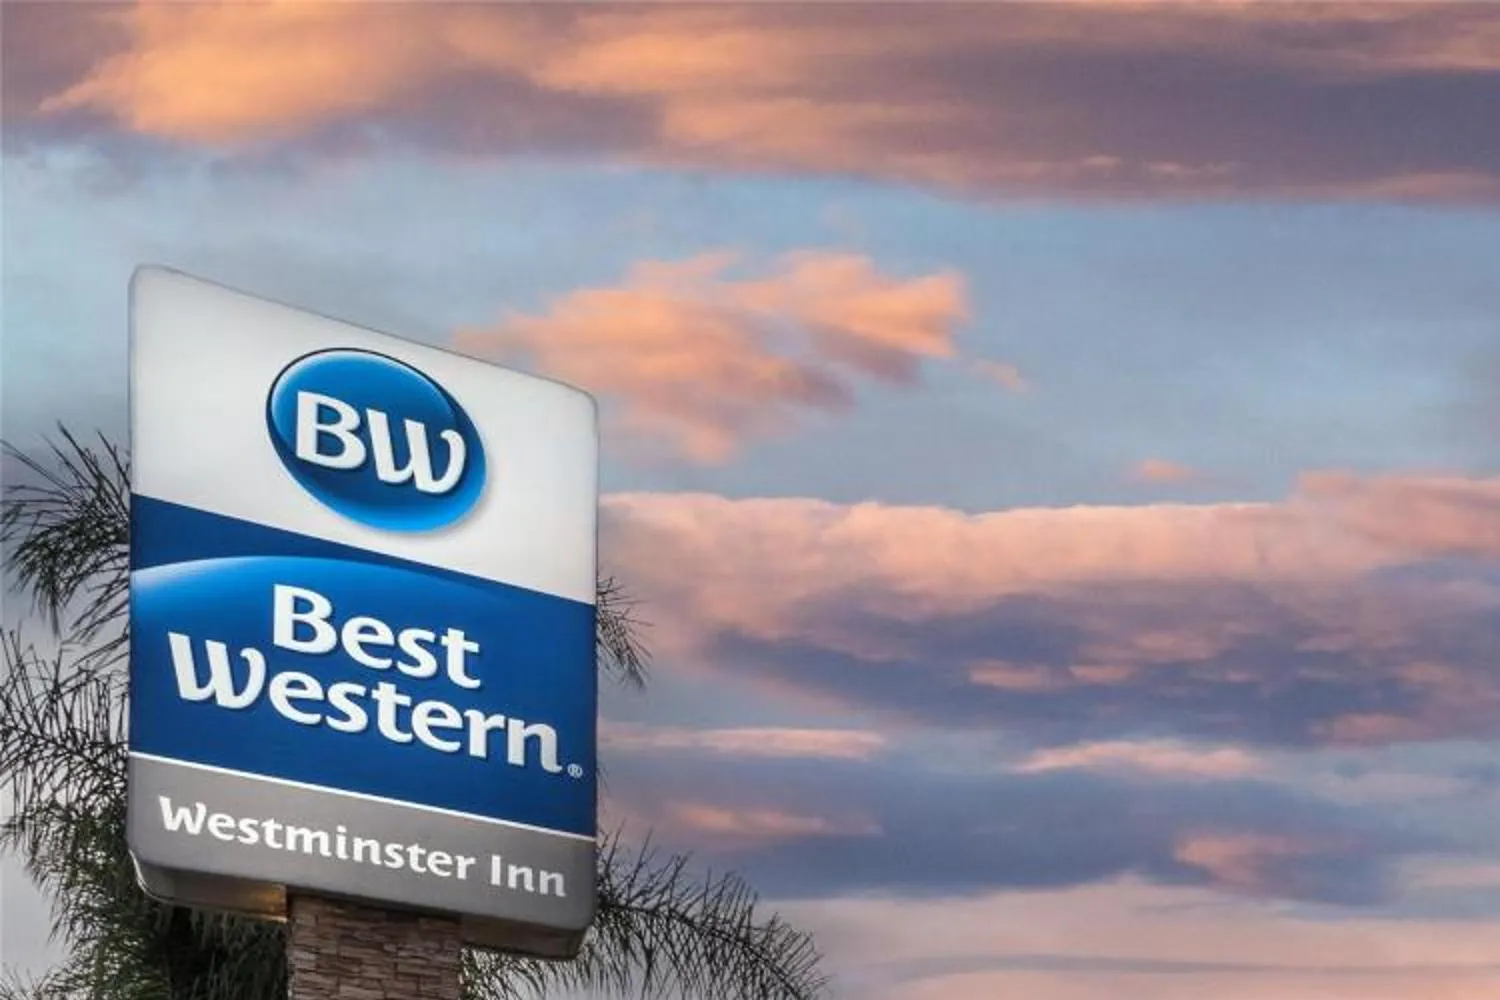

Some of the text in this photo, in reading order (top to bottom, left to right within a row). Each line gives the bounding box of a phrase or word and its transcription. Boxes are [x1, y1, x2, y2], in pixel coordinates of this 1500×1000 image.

[297, 390, 467, 495] BW
[272, 582, 482, 689] Best
[167, 631, 563, 774] Western
[158, 795, 567, 898] Westminster Inn
